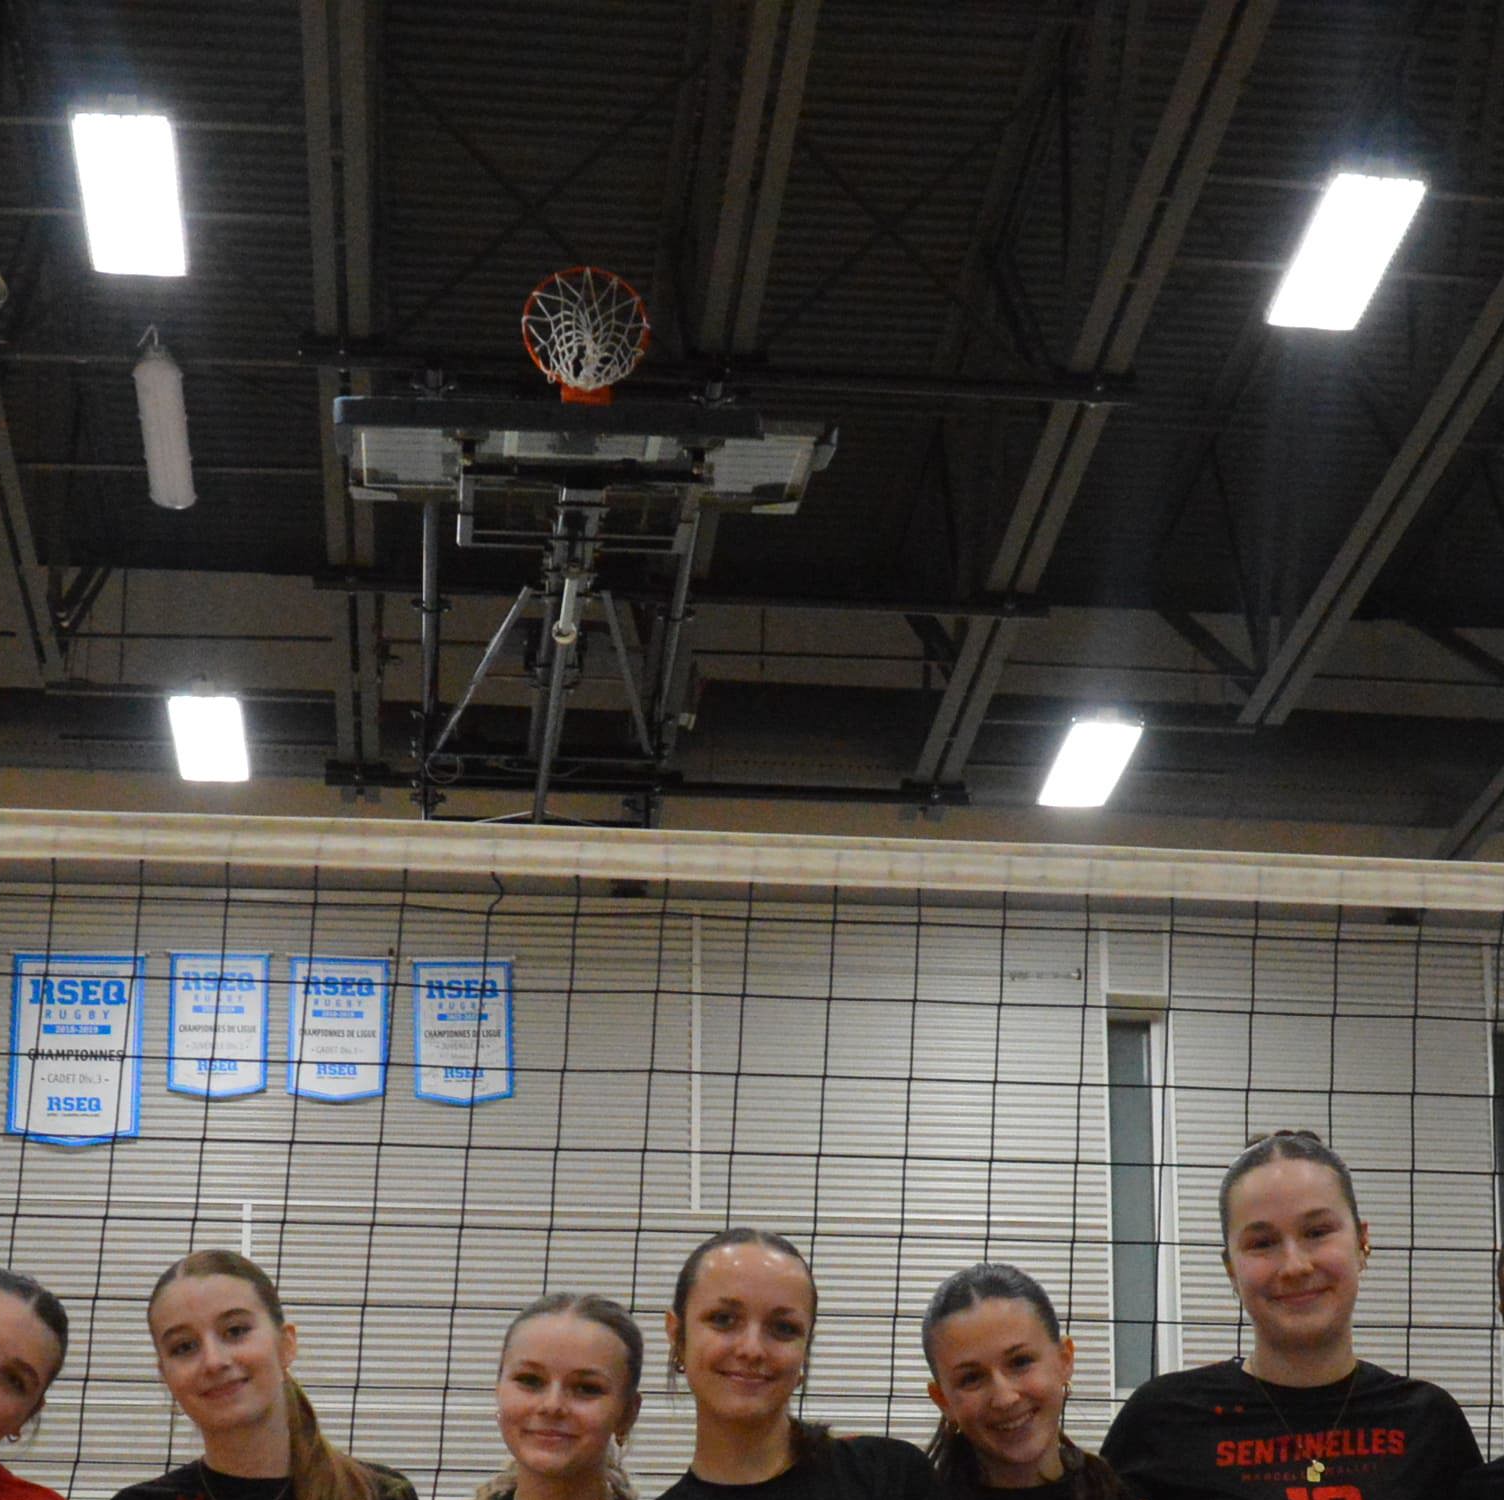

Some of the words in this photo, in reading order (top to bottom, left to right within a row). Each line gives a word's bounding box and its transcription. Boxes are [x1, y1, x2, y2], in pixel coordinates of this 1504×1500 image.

[182, 971, 256, 992] RSEQ
[303, 976, 375, 997] RSEQ
[425, 979, 499, 999] RSEQ
[28, 979, 127, 1006] RSEQ
[45, 1009, 110, 1020] RUGBY
[27, 1048, 124, 1062] CHAMPIONNES
[316, 1063, 357, 1075] RSEQ
[47, 1096, 102, 1112] RSEQ
[1216, 1427, 1406, 1468] SENTINELLES
